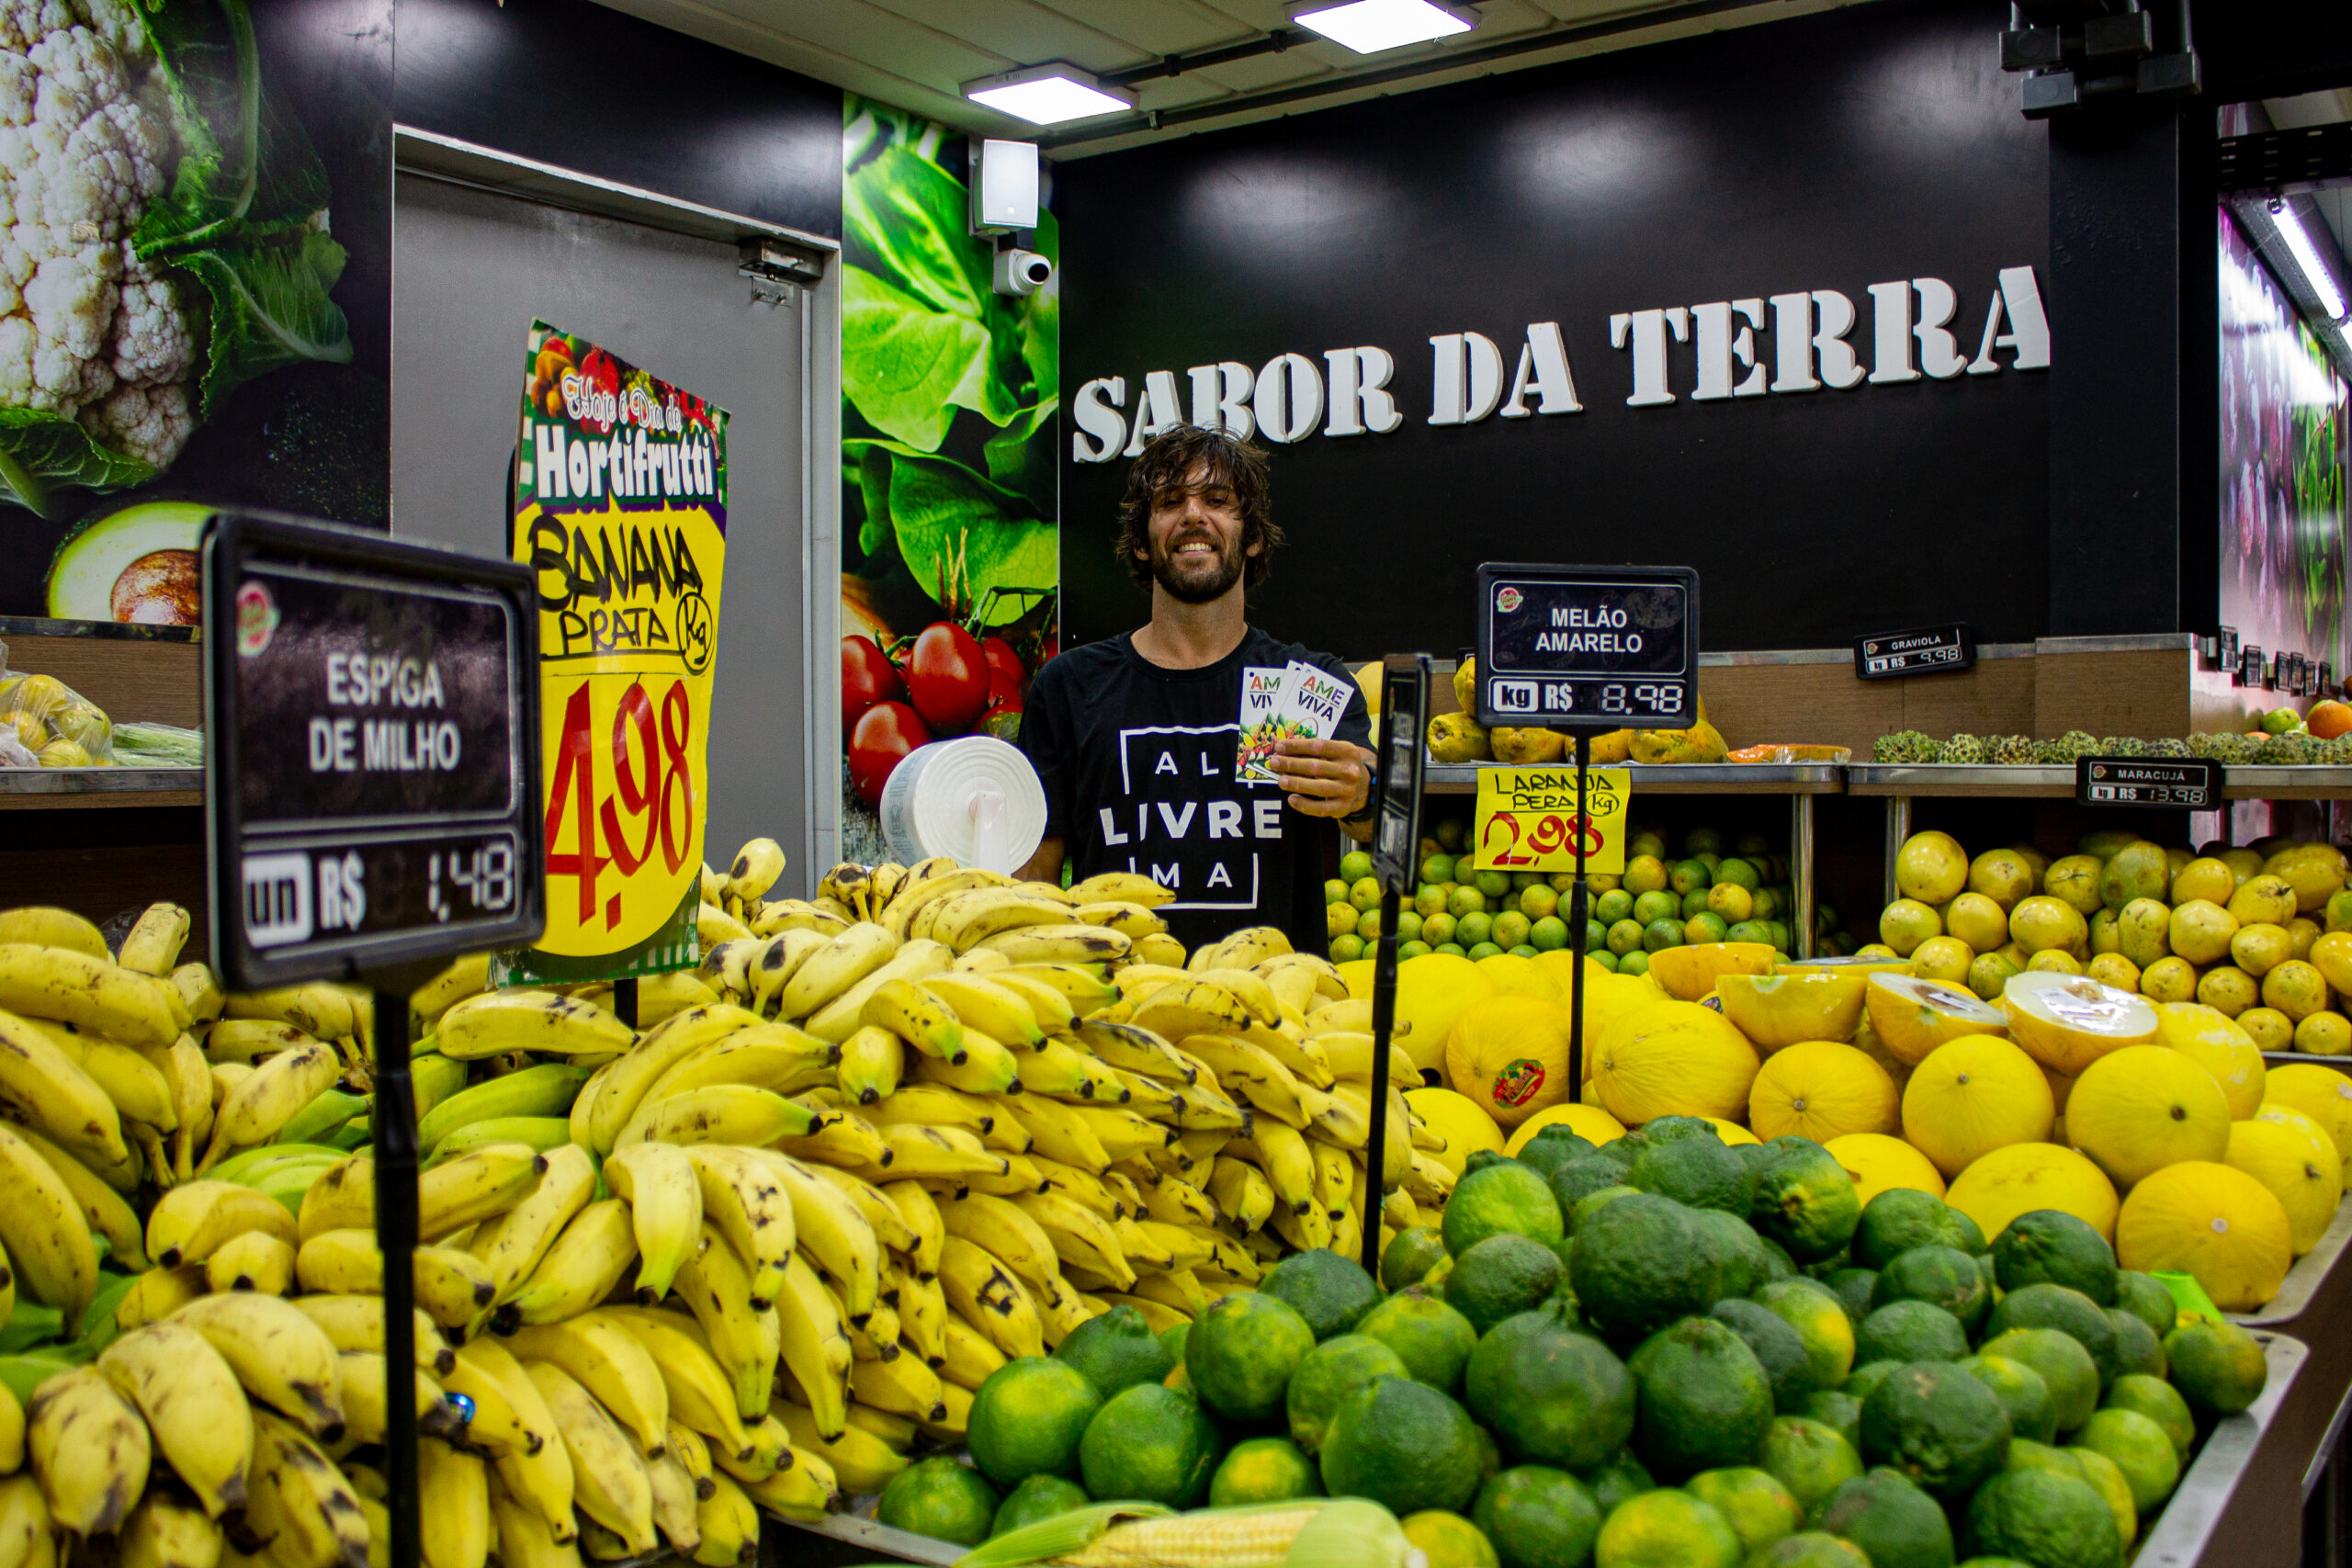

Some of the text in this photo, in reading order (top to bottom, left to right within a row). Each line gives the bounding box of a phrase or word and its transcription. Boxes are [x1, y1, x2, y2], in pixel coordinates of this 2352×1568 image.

[1073, 265, 2051, 464] SABOR DA TERRA
[562, 374, 682, 433] Hoje é Dia de
[535, 424, 714, 498] Hortifrutti
[527, 513, 704, 612] BANANA
[559, 606, 670, 655] PRATA
[1551, 604, 1628, 628] MELÃO
[1535, 632, 1643, 653] AMARELO
[1891, 635, 1941, 650] GRAVIOLA
[1891, 655, 1905, 668] R$
[326, 652, 446, 710] ESPIGA
[1250, 675, 1281, 691] AM
[1302, 675, 1345, 705] AME
[1298, 690, 1334, 722] VIVA
[1501, 684, 1531, 709] kg
[1544, 682, 1573, 712] R$
[308, 716, 461, 773] DE MILHO
[1495, 773, 1614, 795] LARANJA
[2118, 769, 2186, 781] MARACUJÁ
[1512, 794, 1576, 809] PERA
[2119, 787, 2137, 800] R$
[1100, 800, 1282, 846] LIVRE
[318, 849, 367, 932] R$
